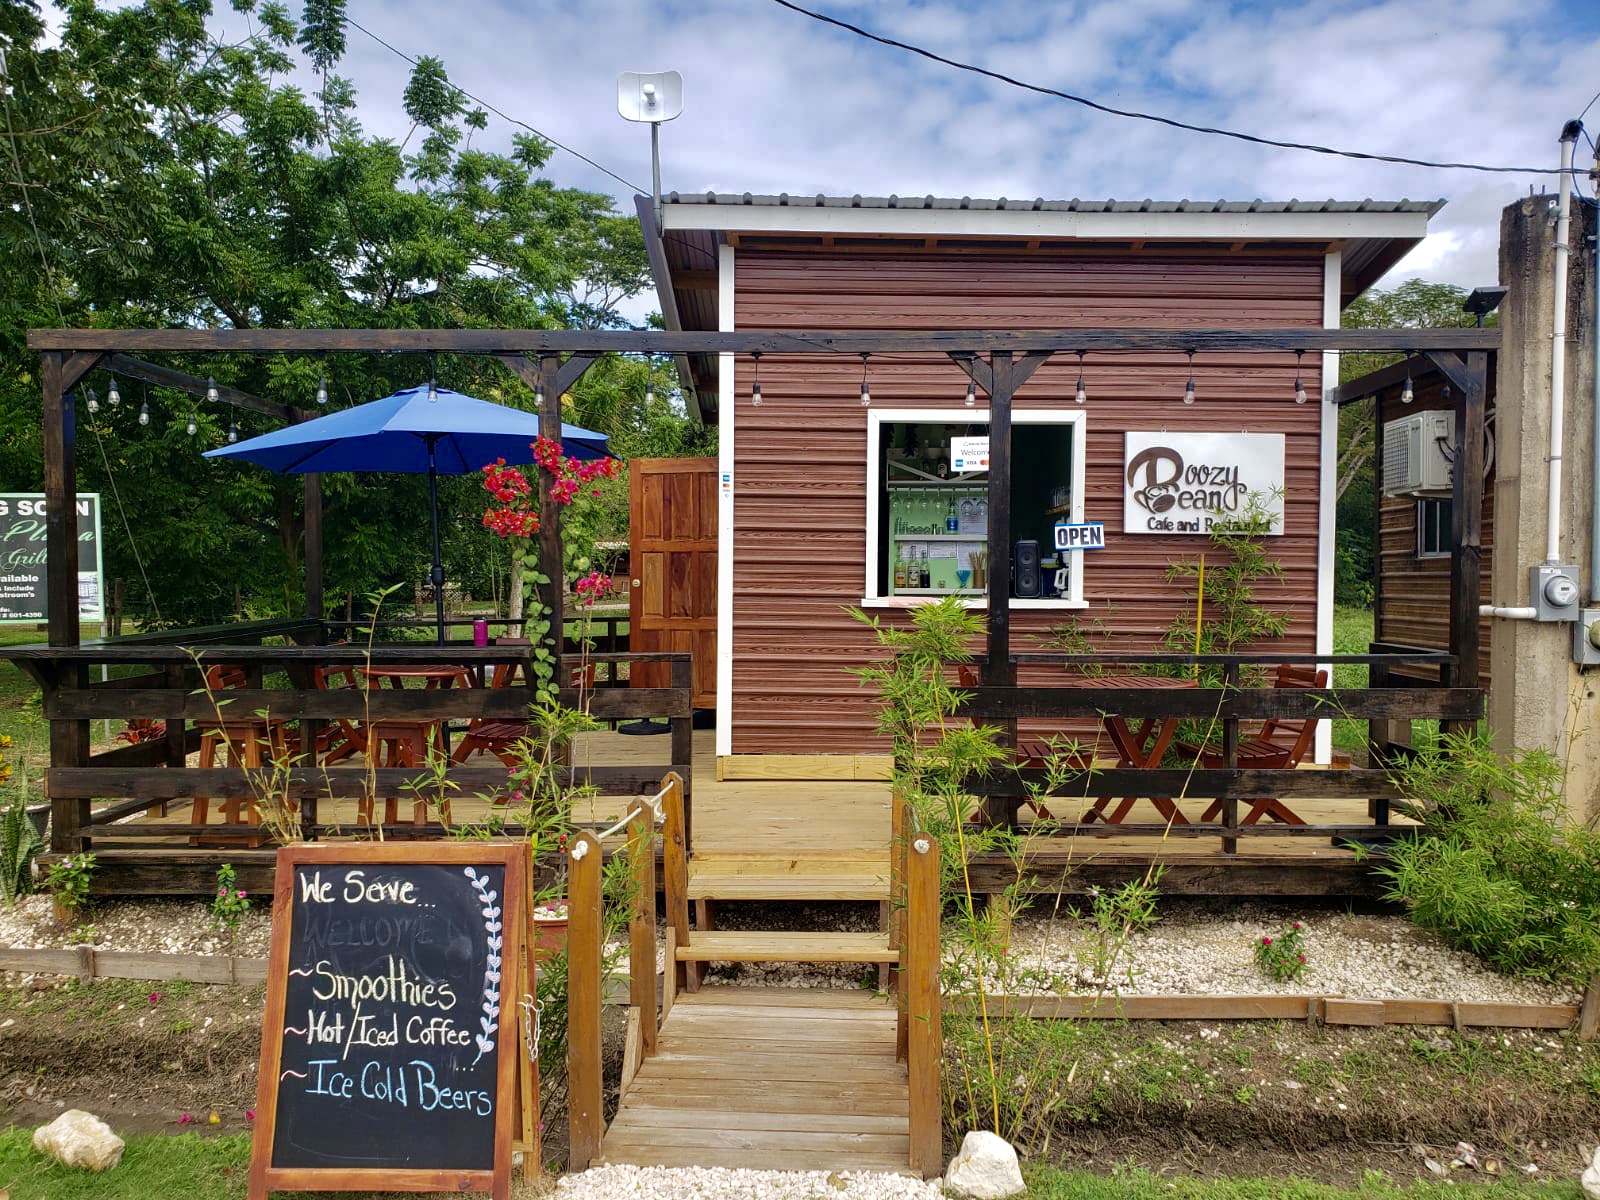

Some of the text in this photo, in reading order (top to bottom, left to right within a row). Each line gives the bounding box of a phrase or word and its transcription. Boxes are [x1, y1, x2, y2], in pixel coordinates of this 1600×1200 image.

[17, 500, 89, 516] SON
[1057, 526, 1102, 547] OPEN
[1147, 517, 1174, 532] Cafe
[1177, 517, 1199, 532] and
[0, 574, 39, 583] ailable
[300, 872, 336, 904] We
[312, 954, 456, 1011] Smoothies
[406, 1015, 471, 1047] Coffee
[305, 1059, 492, 1117] Ice Cold Beers
